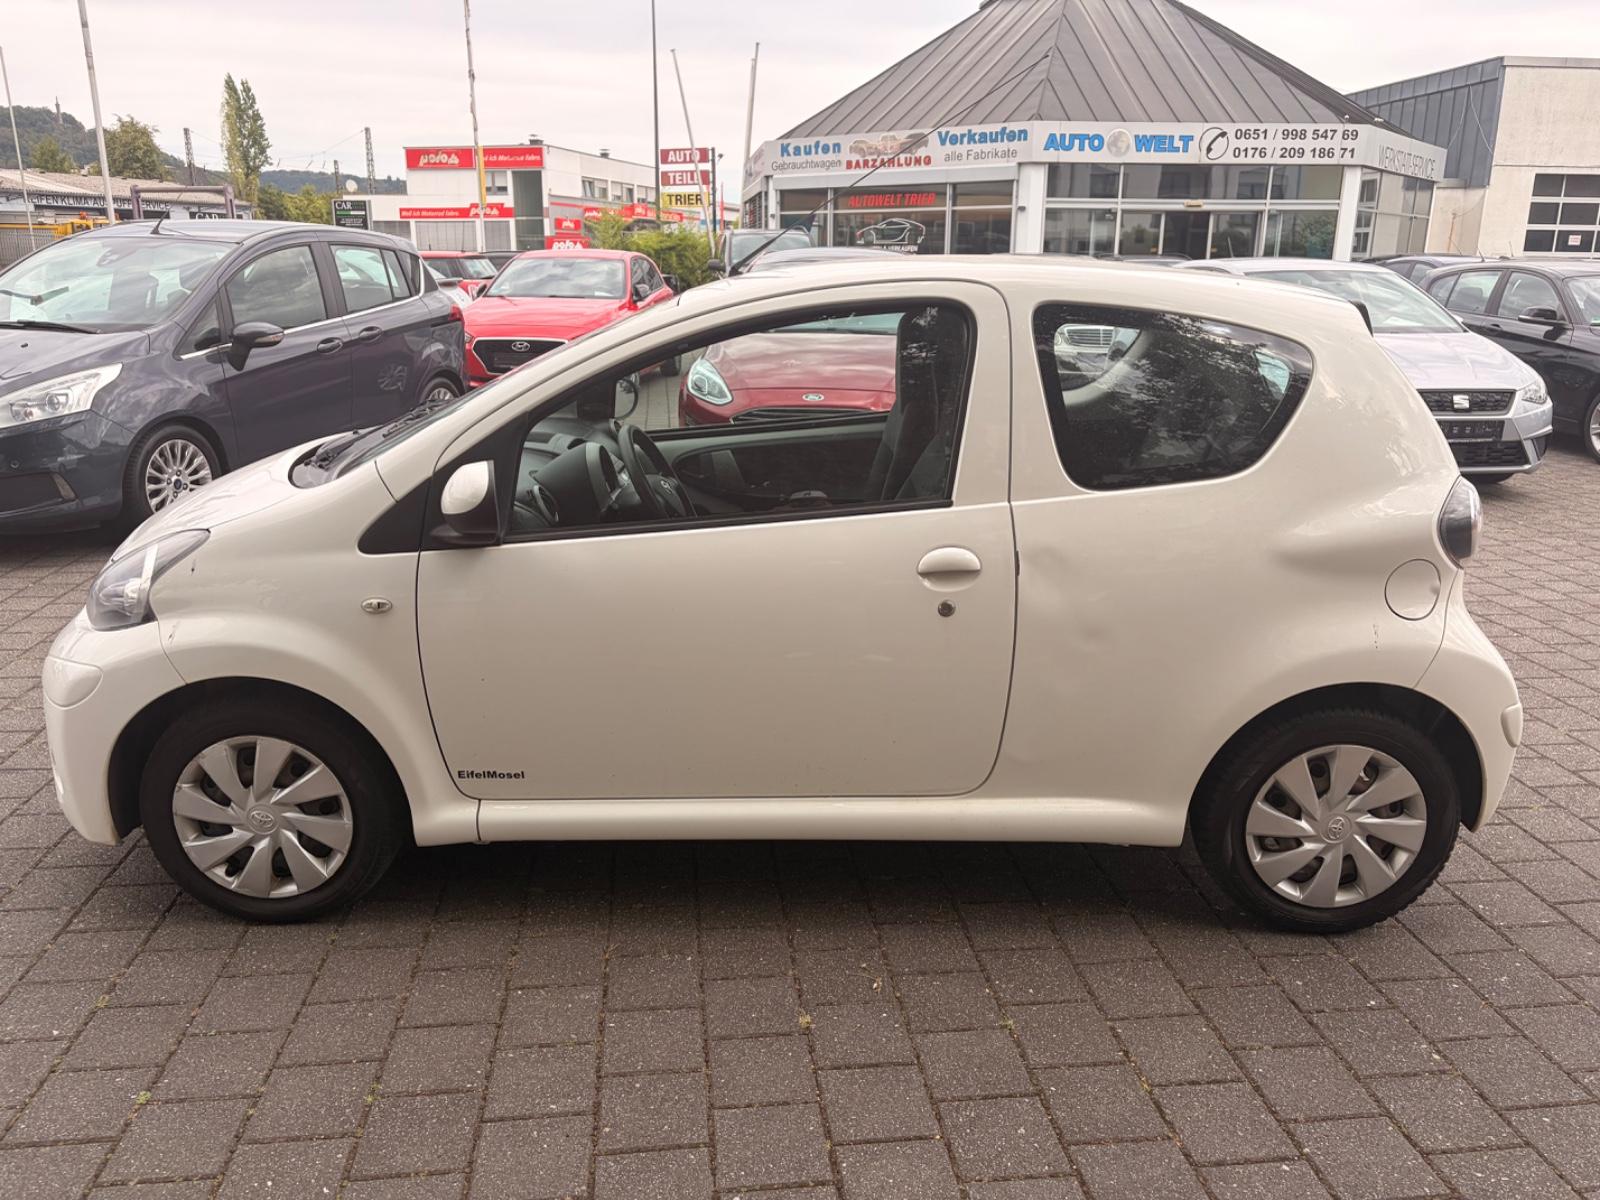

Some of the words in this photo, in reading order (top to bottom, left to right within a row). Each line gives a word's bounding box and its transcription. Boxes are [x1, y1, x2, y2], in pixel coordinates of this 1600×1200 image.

[937, 126, 1028, 146] Verkaufen
[1234, 128, 1268, 141] 0651
[1281, 128, 1307, 141] 998
[1311, 128, 1338, 141] 547
[1341, 129, 1359, 141] 69
[780, 140, 841, 157] Kaufen
[1044, 132, 1104, 152] AUTO
[1134, 134, 1194, 153] WELT
[668, 150, 701, 163] AUTO
[944, 151, 964, 163] alle
[966, 147, 1018, 161] Fabrikate
[1233, 146, 1267, 159] 0176
[1279, 146, 1305, 159] 209
[1310, 146, 1335, 159] 186
[1340, 147, 1356, 159] 71
[771, 159, 841, 172] Gebrauchtwagen
[846, 155, 932, 170] BARZAHLUNG
[61, 196, 90, 206] KLIMA
[141, 202, 170, 211] ERVICE
[335, 201, 352, 210] CAR
[667, 194, 703, 205] TRIER
[457, 770, 525, 780] EifelMosel
